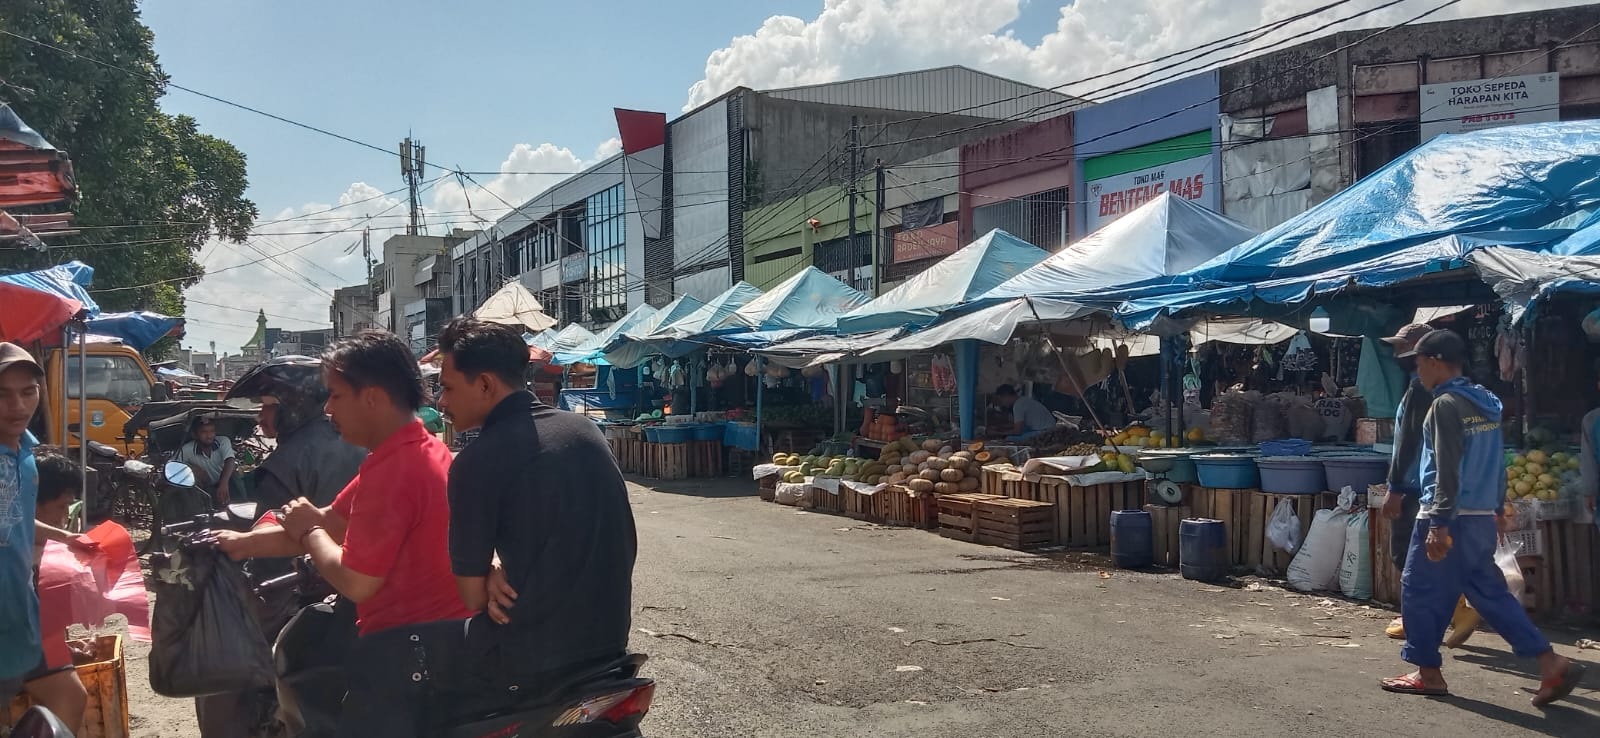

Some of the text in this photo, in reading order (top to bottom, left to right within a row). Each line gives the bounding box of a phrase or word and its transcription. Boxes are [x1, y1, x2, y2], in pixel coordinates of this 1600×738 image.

[1451, 80, 1526, 95] TOKO SEPEDA
[1448, 94, 1501, 106] HARAPAN
[1503, 91, 1529, 101] KITA
[1134, 170, 1165, 186] TOKO MAS
[1169, 173, 1205, 201] MAS
